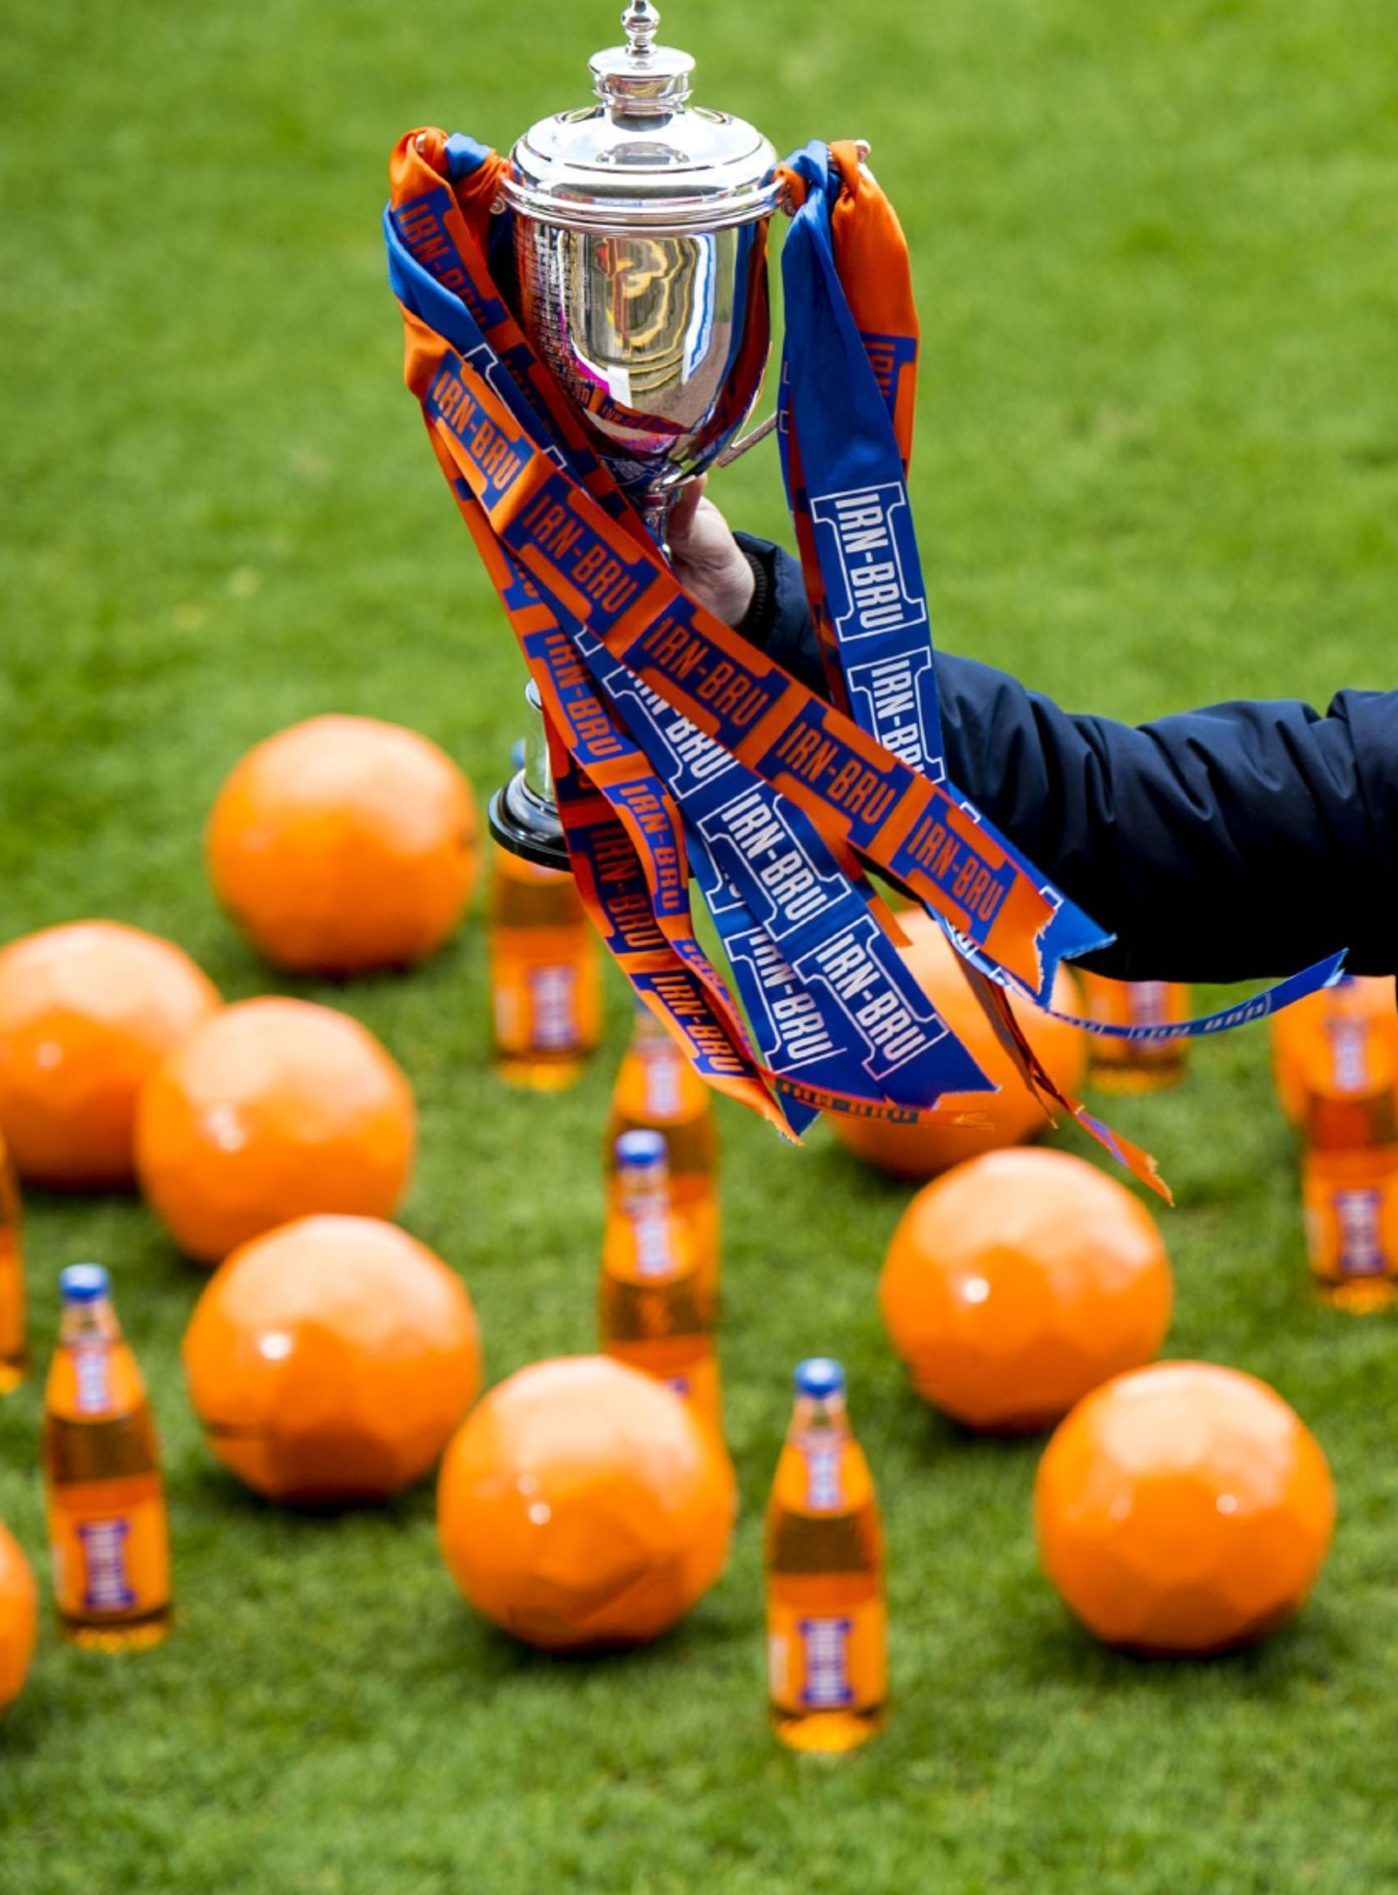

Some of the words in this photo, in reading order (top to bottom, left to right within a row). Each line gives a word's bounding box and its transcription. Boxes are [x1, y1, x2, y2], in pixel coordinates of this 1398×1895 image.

[431, 372, 520, 490] IRN-BRU
[522, 498, 638, 613] IRN-BRU
[835, 492, 904, 630] IRN-BRU
[642, 615, 769, 726] IRN-BRU
[776, 721, 896, 825] IRN-BRU
[590, 826, 666, 948] IRN-BRU
[620, 784, 680, 909] IRN-BRU
[721, 793, 829, 922] IRN-BRU
[905, 816, 1004, 922] IRN-BRU
[651, 975, 745, 1073] IRN-BRU
[749, 931, 834, 1060] IRN-BRU
[815, 933, 927, 1062] IRN-BRU
